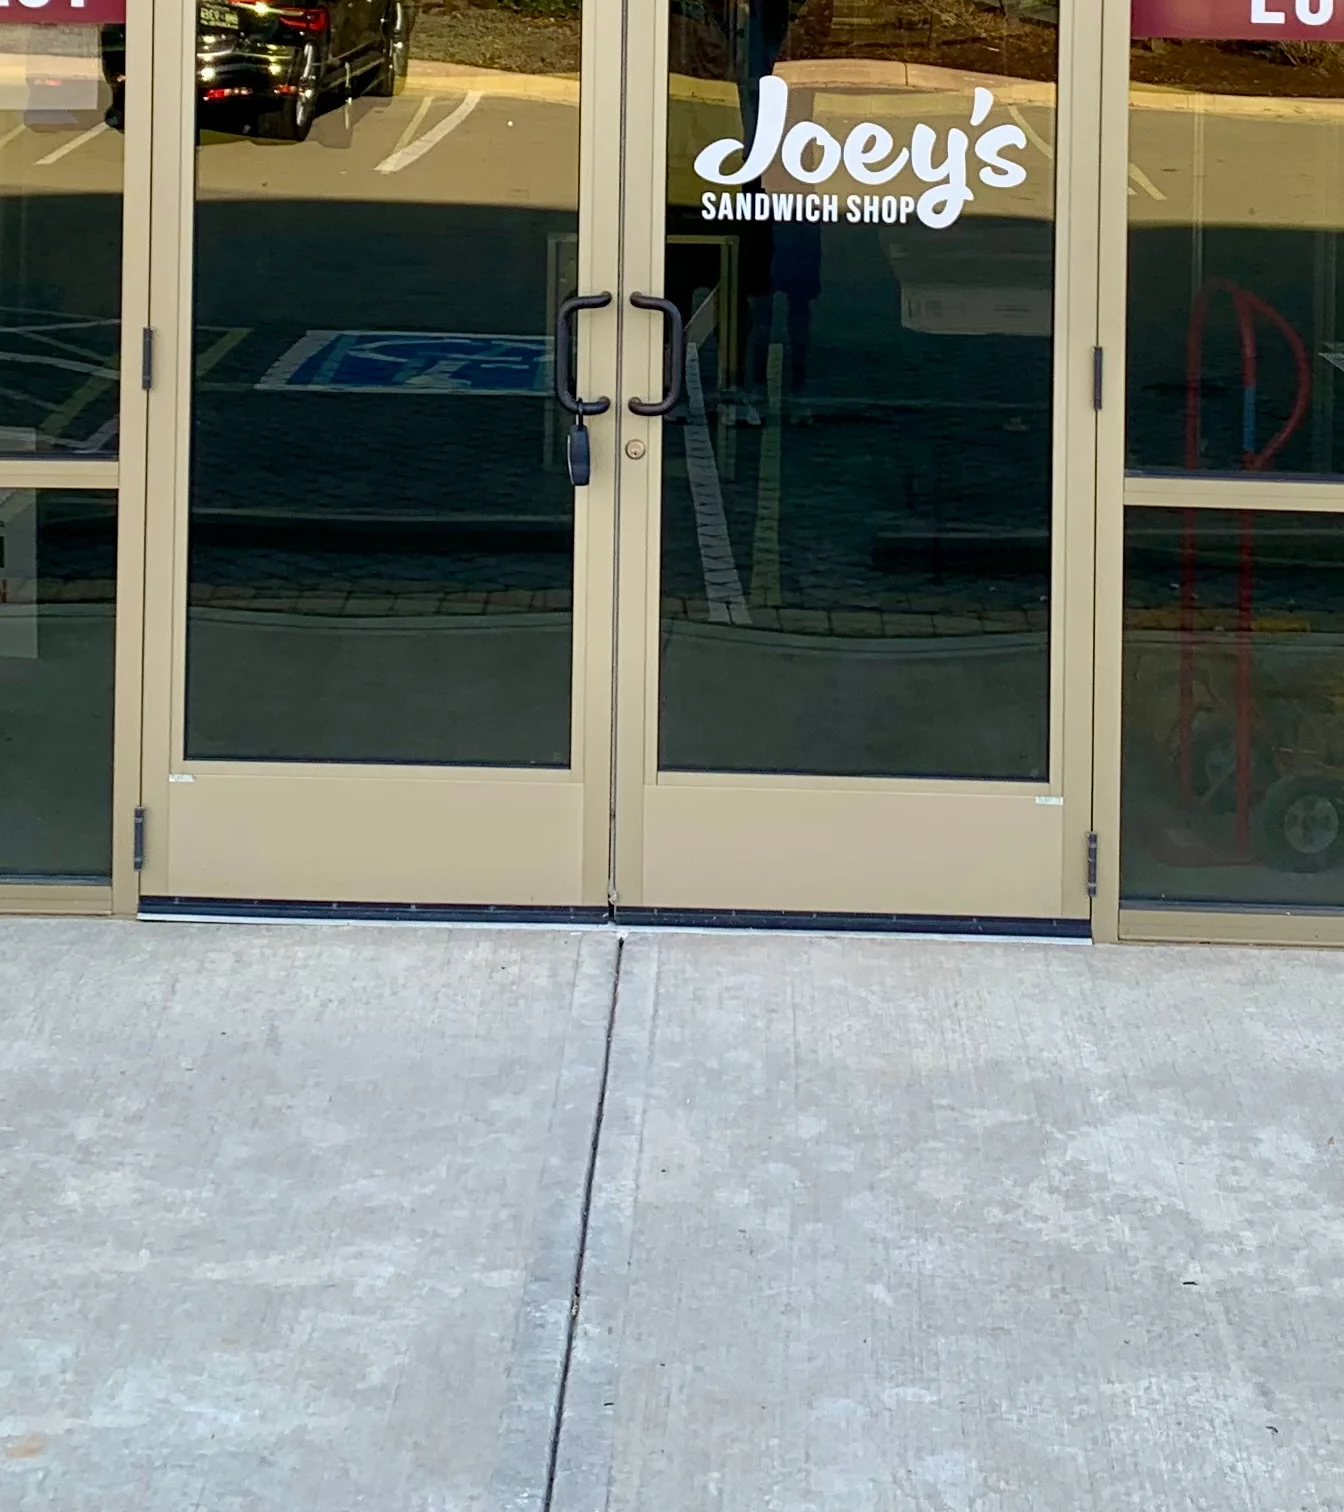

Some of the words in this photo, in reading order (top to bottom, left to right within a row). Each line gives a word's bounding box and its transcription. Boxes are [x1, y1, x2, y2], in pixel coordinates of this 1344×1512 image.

[694, 75, 1027, 229] Joey's
[701, 192, 838, 222] SANDWICH
[846, 194, 915, 224] SHOP
